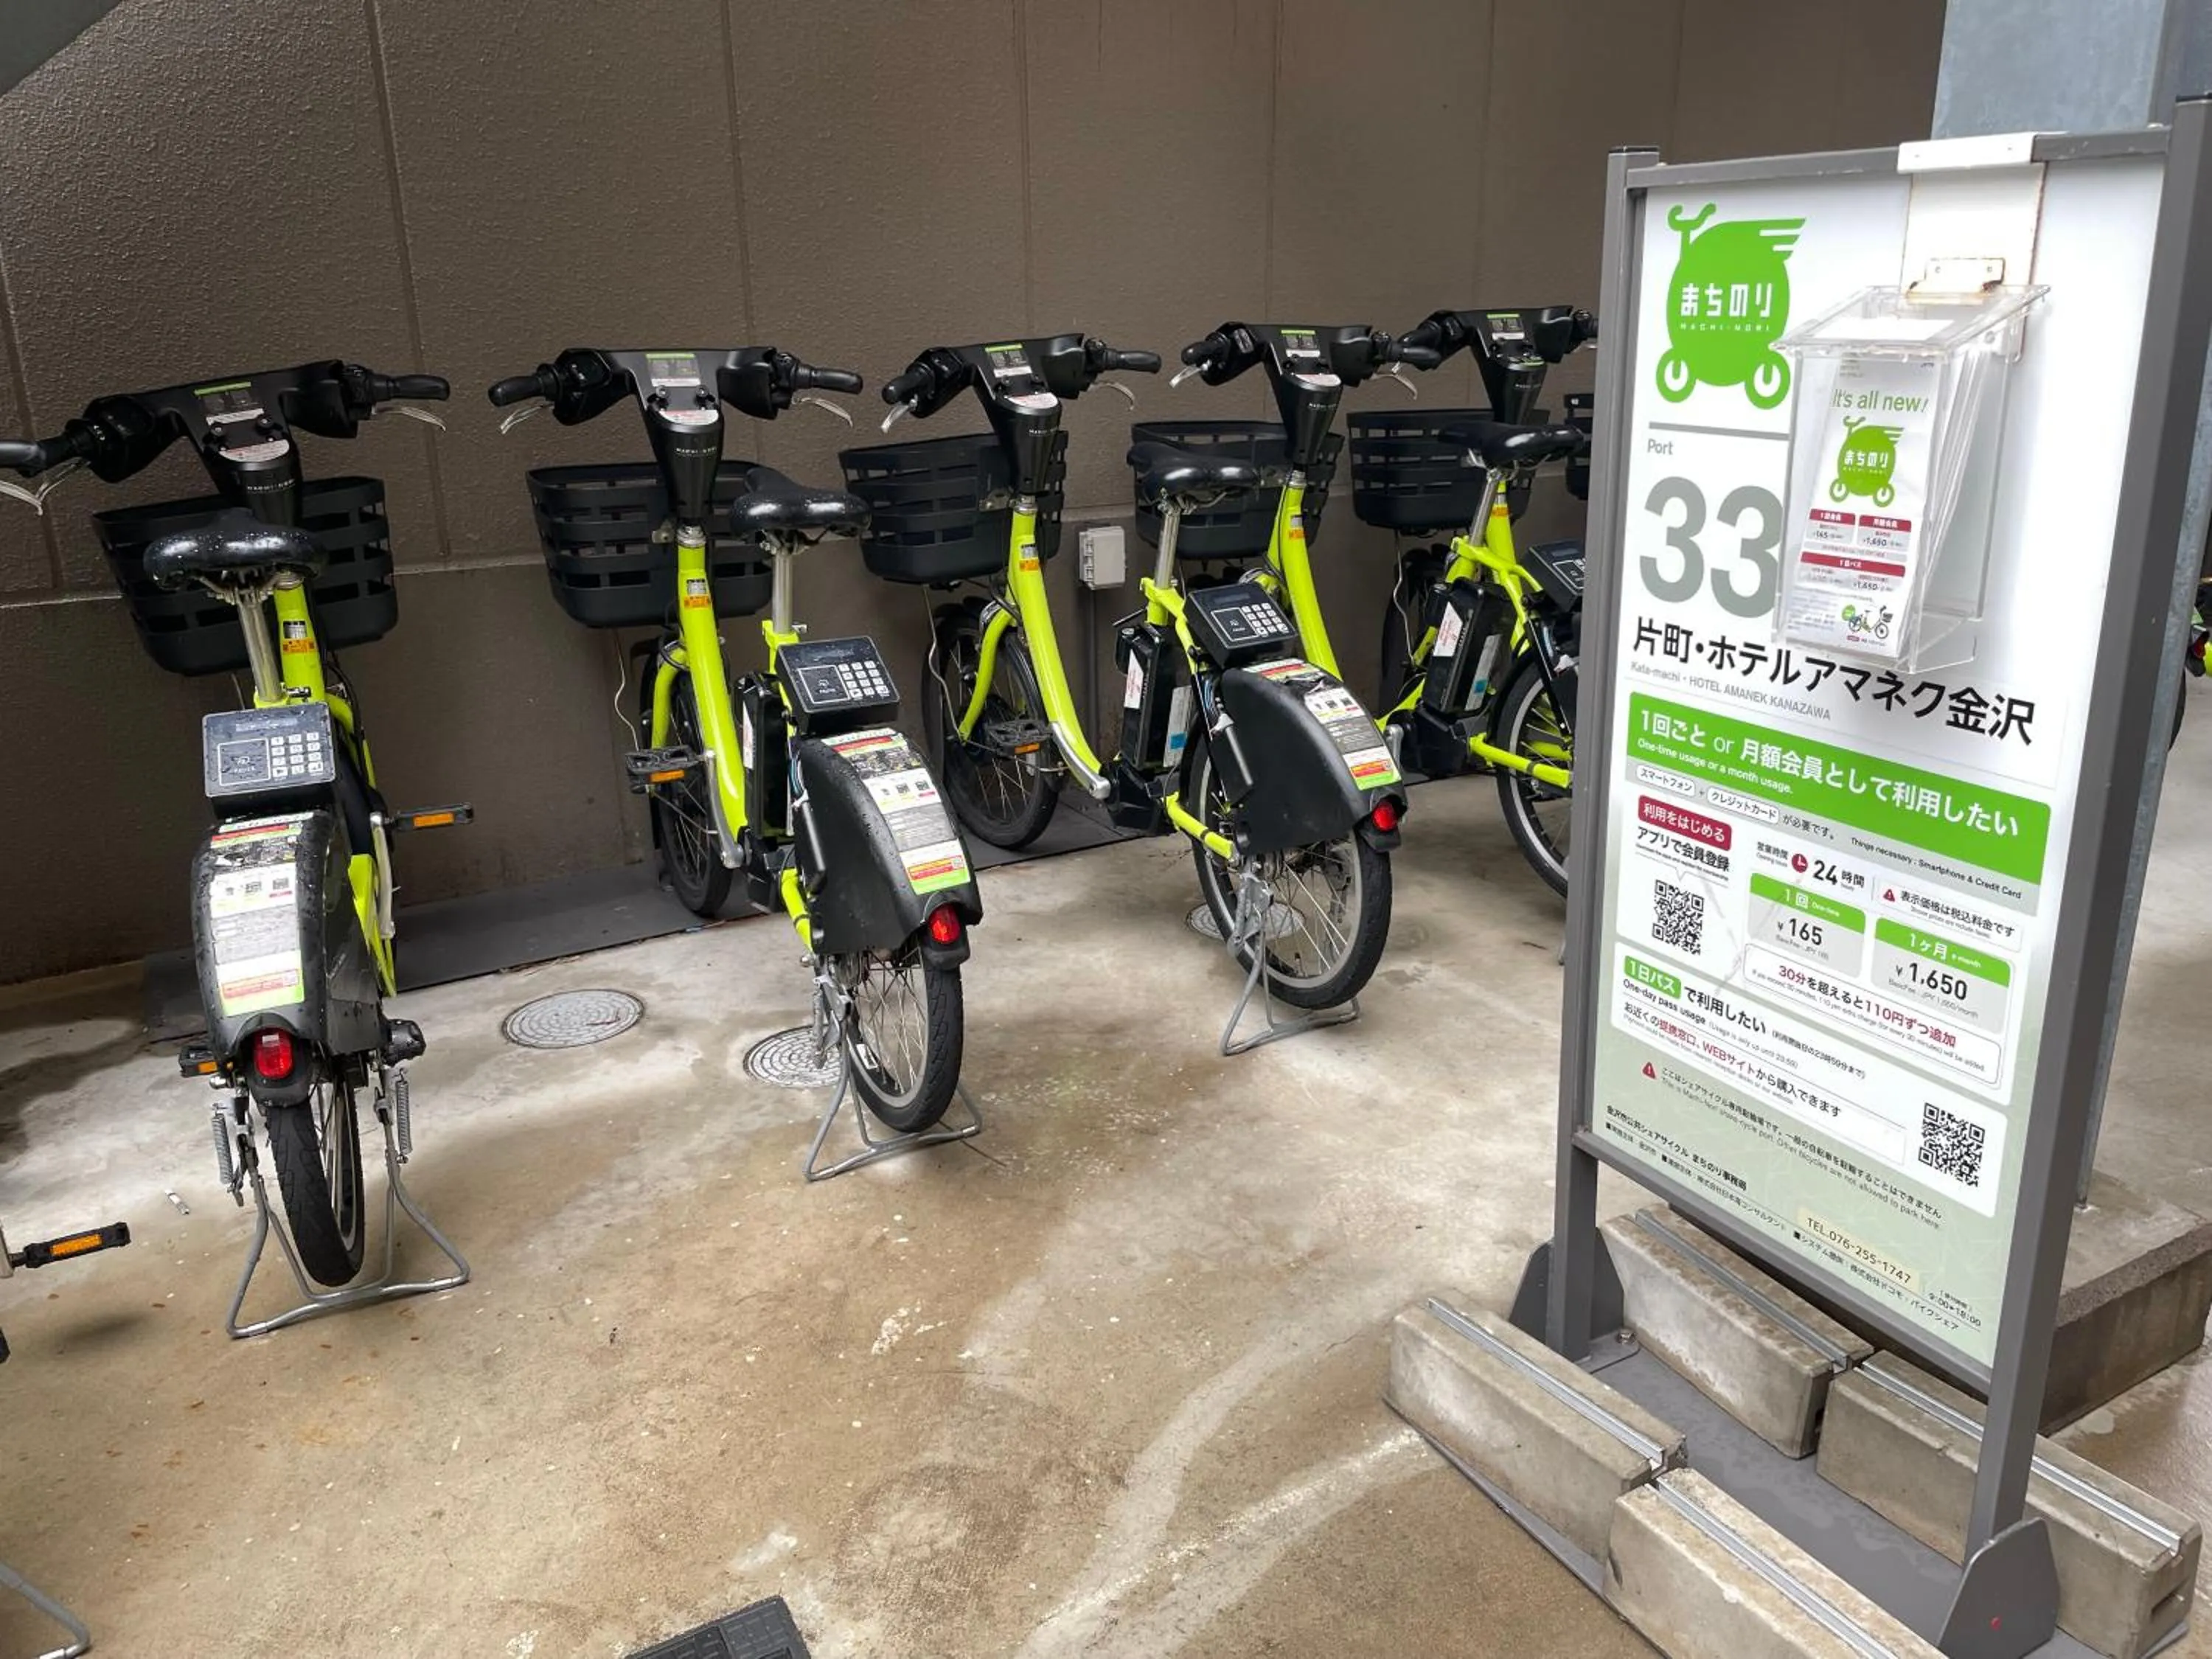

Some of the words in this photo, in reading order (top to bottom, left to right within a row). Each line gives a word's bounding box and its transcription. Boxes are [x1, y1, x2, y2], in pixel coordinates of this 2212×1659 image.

[1680, 283, 1772, 317] まちのり
[1832, 389, 1853, 408] It's
[1857, 390, 1879, 411] all
[1882, 395, 1929, 413] new!
[1647, 439, 1673, 456] Port
[1844, 450, 1888, 468] まちのり
[1639, 476, 1784, 619] 33
[1632, 611, 2037, 751] 片町・ホテルアマネク金沢
[1688, 674, 1721, 693] HOTEL
[1722, 683, 1767, 705] AMANEK
[1769, 694, 1831, 722] KANAZAWA
[1637, 737, 1677, 759] One-time
[1678, 750, 1705, 770] usage
[1706, 759, 1718, 771] or
[1719, 762, 1726, 773] a
[1727, 763, 1759, 784] month
[1759, 775, 1793, 797] usage.
[1640, 707, 1707, 751] 1回ごと
[1713, 734, 1734, 757] or
[1739, 734, 2020, 844] 月額会員として利用したい
[1640, 767, 1692, 793] スマートフォン
[1711, 789, 1776, 821] クレジットカード
[1643, 801, 1725, 844] 利用をはじめる
[1636, 824, 1731, 874] アプリで会員登録
[1812, 858, 1839, 887] 24
[1840, 869, 1865, 888] 時間
[1850, 836, 1874, 853] Things
[1874, 845, 1913, 866] necessary
[1918, 858, 1965, 883] Smartphone
[1975, 876, 2000, 892] Credit
[2000, 884, 2023, 900] Card
[1900, 888, 2015, 940] 表示価格は税込料金です
[1909, 931, 1948, 961] 1ヶ月
[1623, 977, 1657, 1003] One-day
[1658, 995, 1677, 1012] pass
[1679, 1006, 1705, 1027] usage
[1629, 959, 1676, 996] 1日パス
[1683, 984, 1767, 1037] で利用したい
[1778, 961, 1957, 1050] 30分を超えると110円ずつ追加
